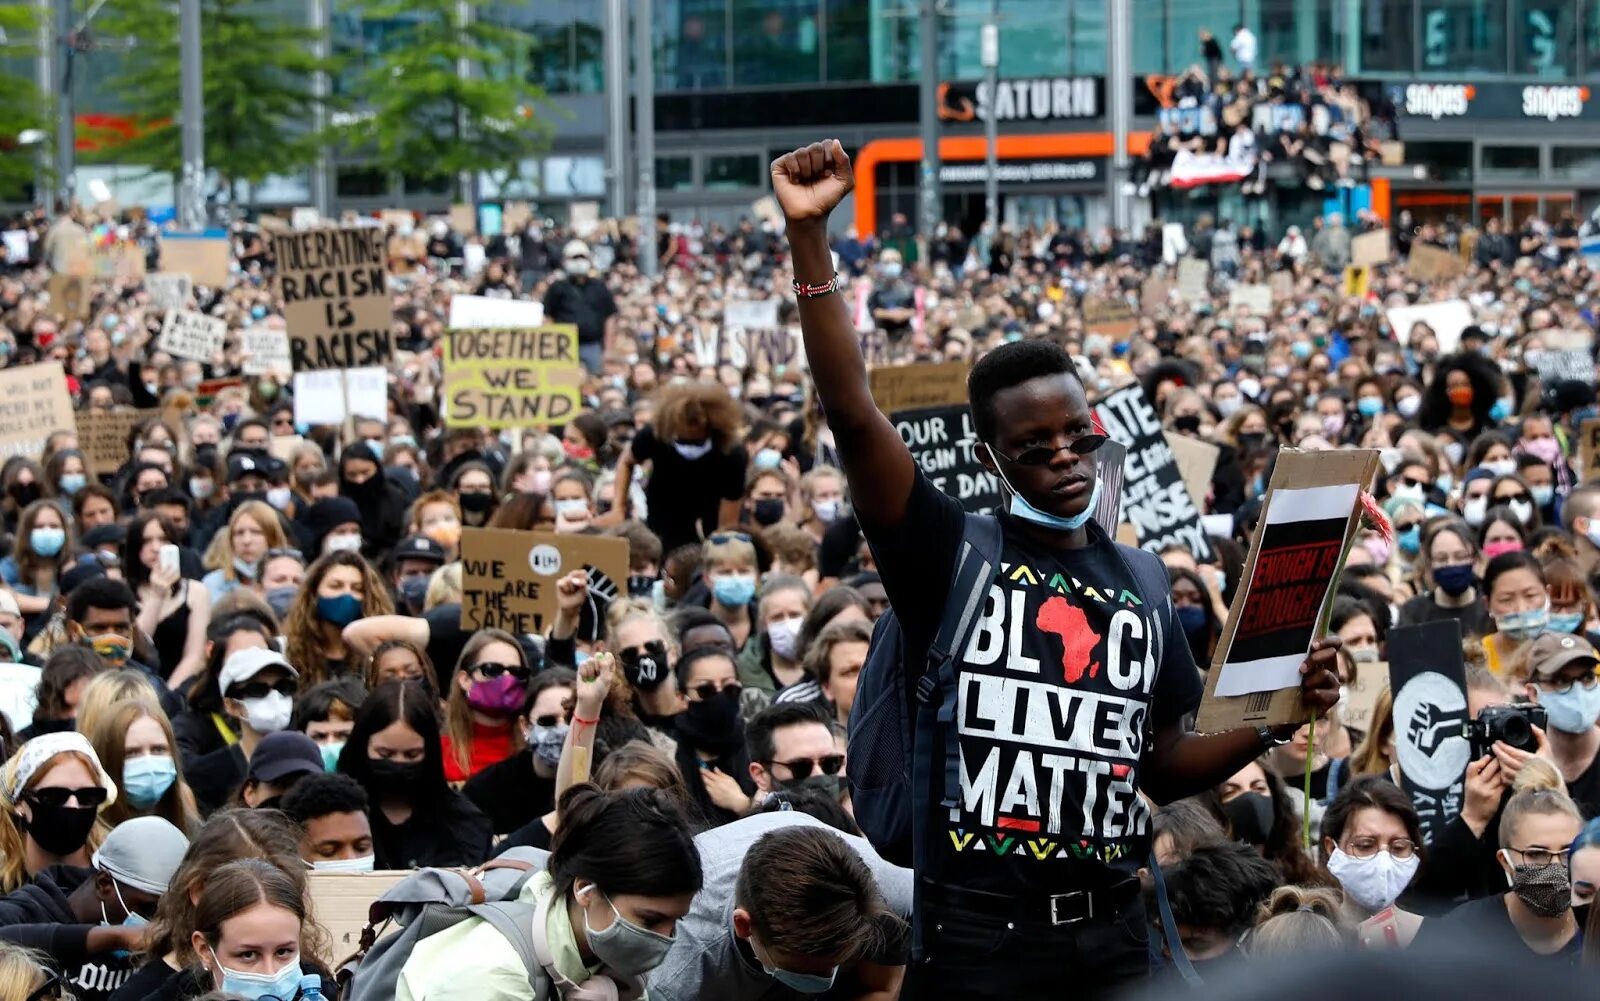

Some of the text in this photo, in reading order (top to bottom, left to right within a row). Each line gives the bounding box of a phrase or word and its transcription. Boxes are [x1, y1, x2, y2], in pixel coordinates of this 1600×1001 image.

[976, 78, 1096, 120] SATURN
[276, 228, 382, 271] TOLERATING
[282, 268, 386, 302] RACISM
[325, 302, 355, 328] IS
[291, 329, 393, 371] RACISM
[447, 331, 574, 361] TOGETHER
[483, 369, 537, 390] WE
[452, 391, 572, 420] STAND
[1096, 384, 1162, 449] ATE
[896, 416, 949, 448] OUR
[956, 471, 999, 499] DAY
[464, 560, 506, 578] WE
[1252, 544, 1338, 589] ENOUGH IS
[464, 589, 510, 613] THE
[504, 579, 541, 599] ARE
[468, 607, 543, 634] SAME!
[963, 584, 1156, 694] BLC
[963, 676, 1143, 757] LIVES
